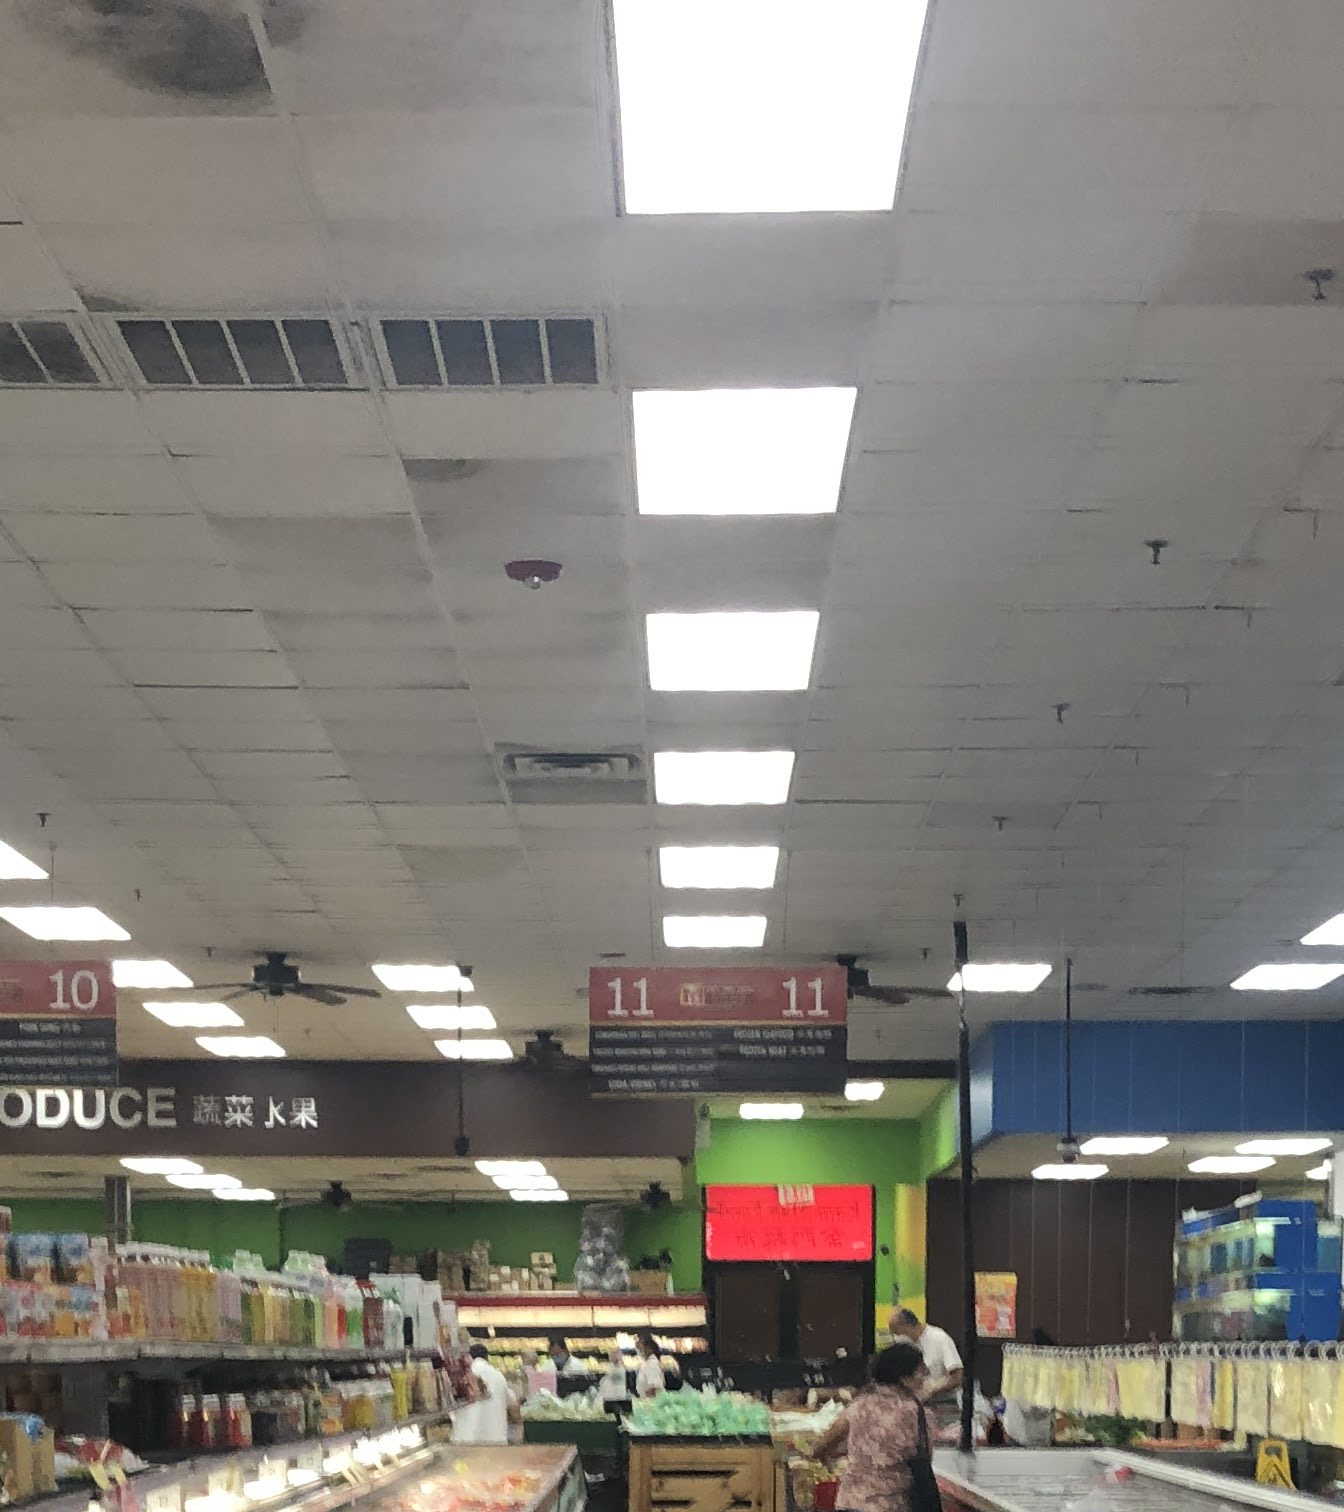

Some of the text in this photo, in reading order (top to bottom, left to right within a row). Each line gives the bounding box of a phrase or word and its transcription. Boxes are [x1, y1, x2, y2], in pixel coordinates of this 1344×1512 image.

[48, 969, 99, 1010] 10
[607, 977, 655, 1018] 11
[782, 977, 829, 1018] 11
